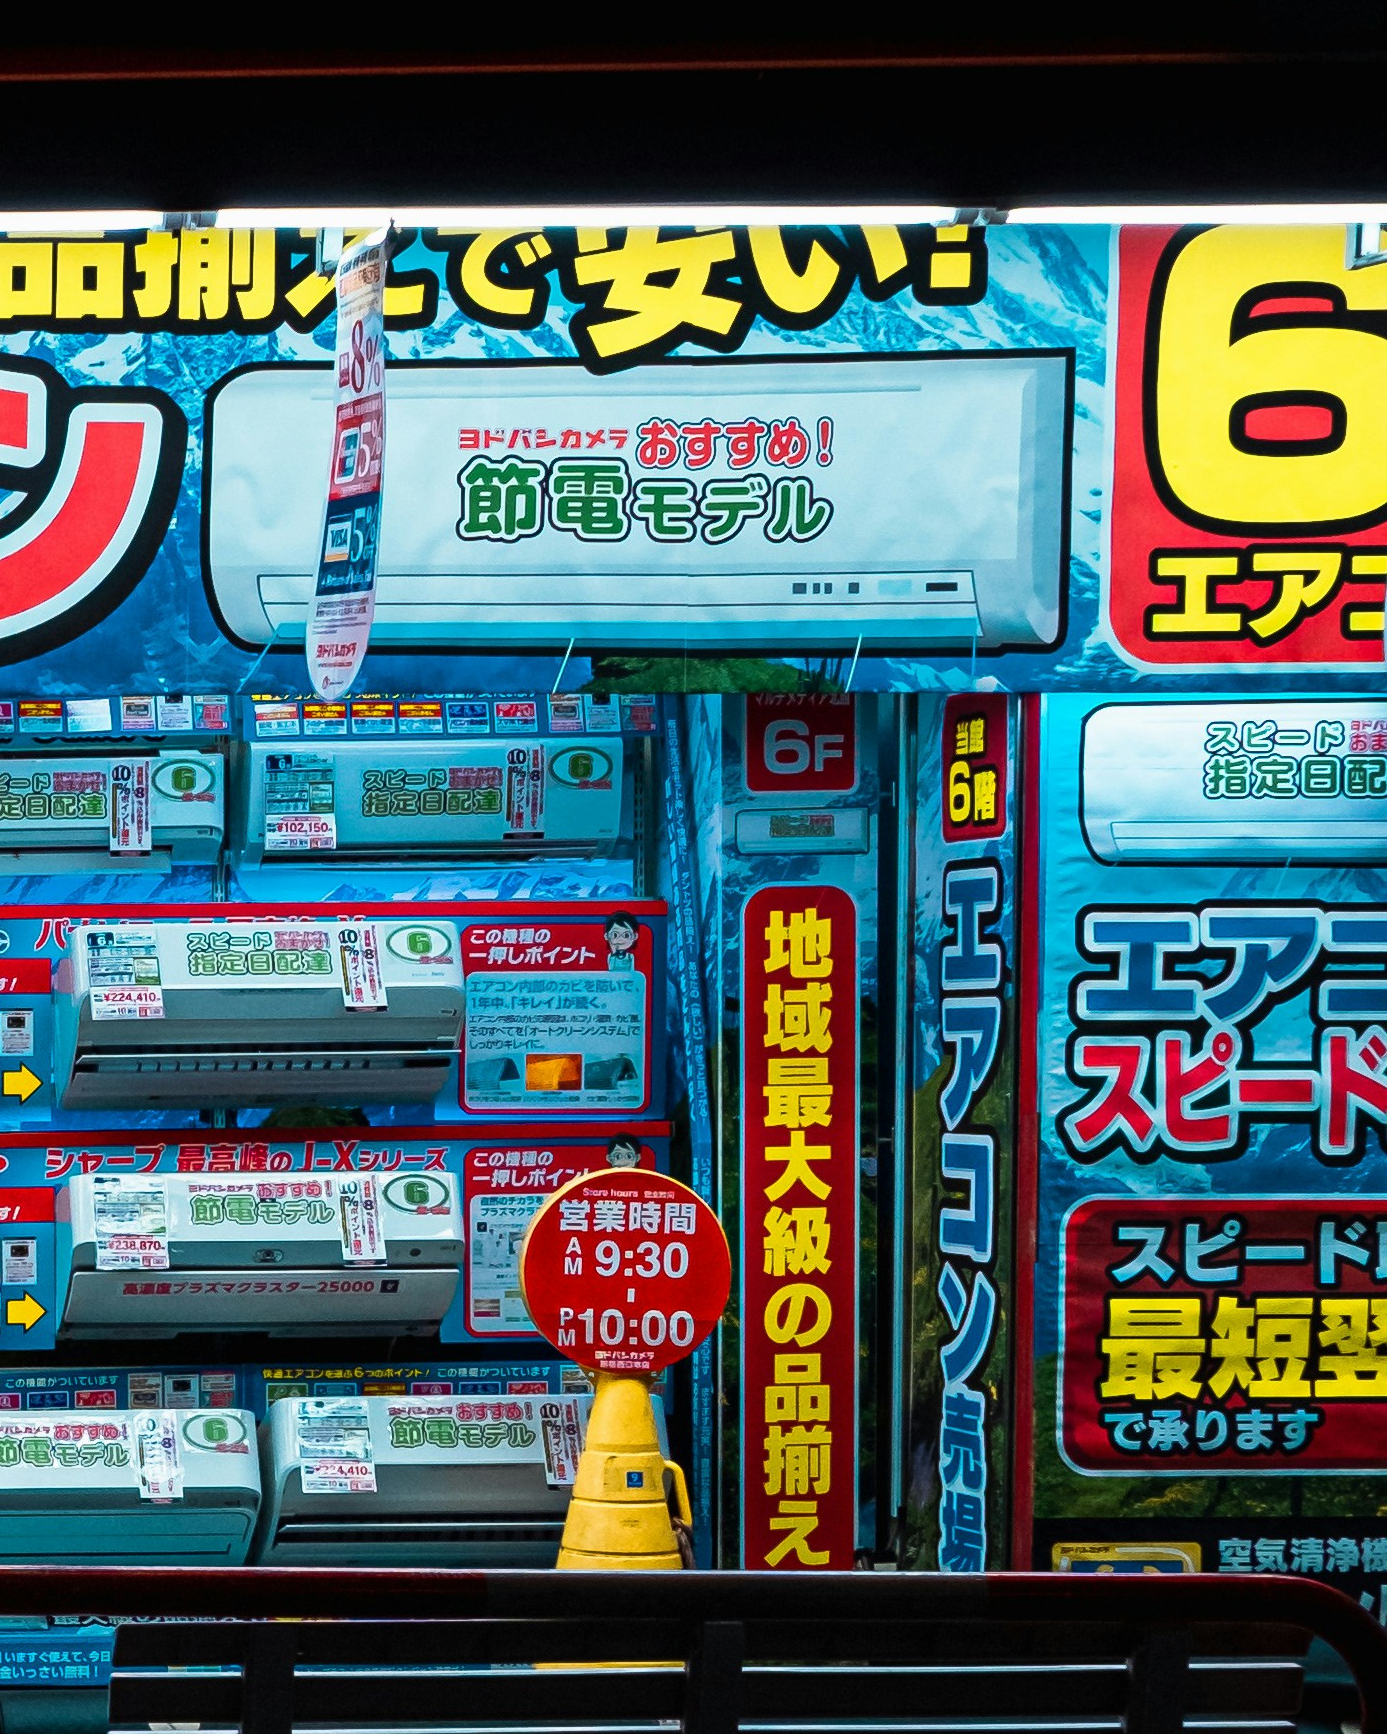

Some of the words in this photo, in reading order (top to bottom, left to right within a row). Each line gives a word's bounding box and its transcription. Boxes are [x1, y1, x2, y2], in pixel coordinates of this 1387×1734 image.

[459, 428, 629, 450] ヨドバシカメラ
[637, 417, 833, 468] おすすめ!
[458, 457, 834, 545] 節電モデル
[763, 719, 845, 775] 6F
[1205, 721, 1343, 754] スピード
[171, 766, 196, 792] 6
[568, 753, 594, 776] 6
[948, 760, 998, 822] 6階
[277, 822, 327, 833] ¥102,150
[406, 931, 433, 953] 6
[103, 992, 156, 1003] ¥224,410
[44, 1143, 167, 1178] シャープ
[403, 1181, 429, 1204] 6
[559, 1199, 696, 1234] 営業時間
[763, 907, 834, 1566] 地域最大級の品揃え
[1111, 1219, 1387, 1285] スピード
[595, 1240, 690, 1279] 9:30
[578, 1308, 695, 1347] 10:00
[204, 1419, 226, 1441] 6
[391, 1418, 536, 1448] 節電モデル
[1103, 1408, 1320, 1451] で承ります
